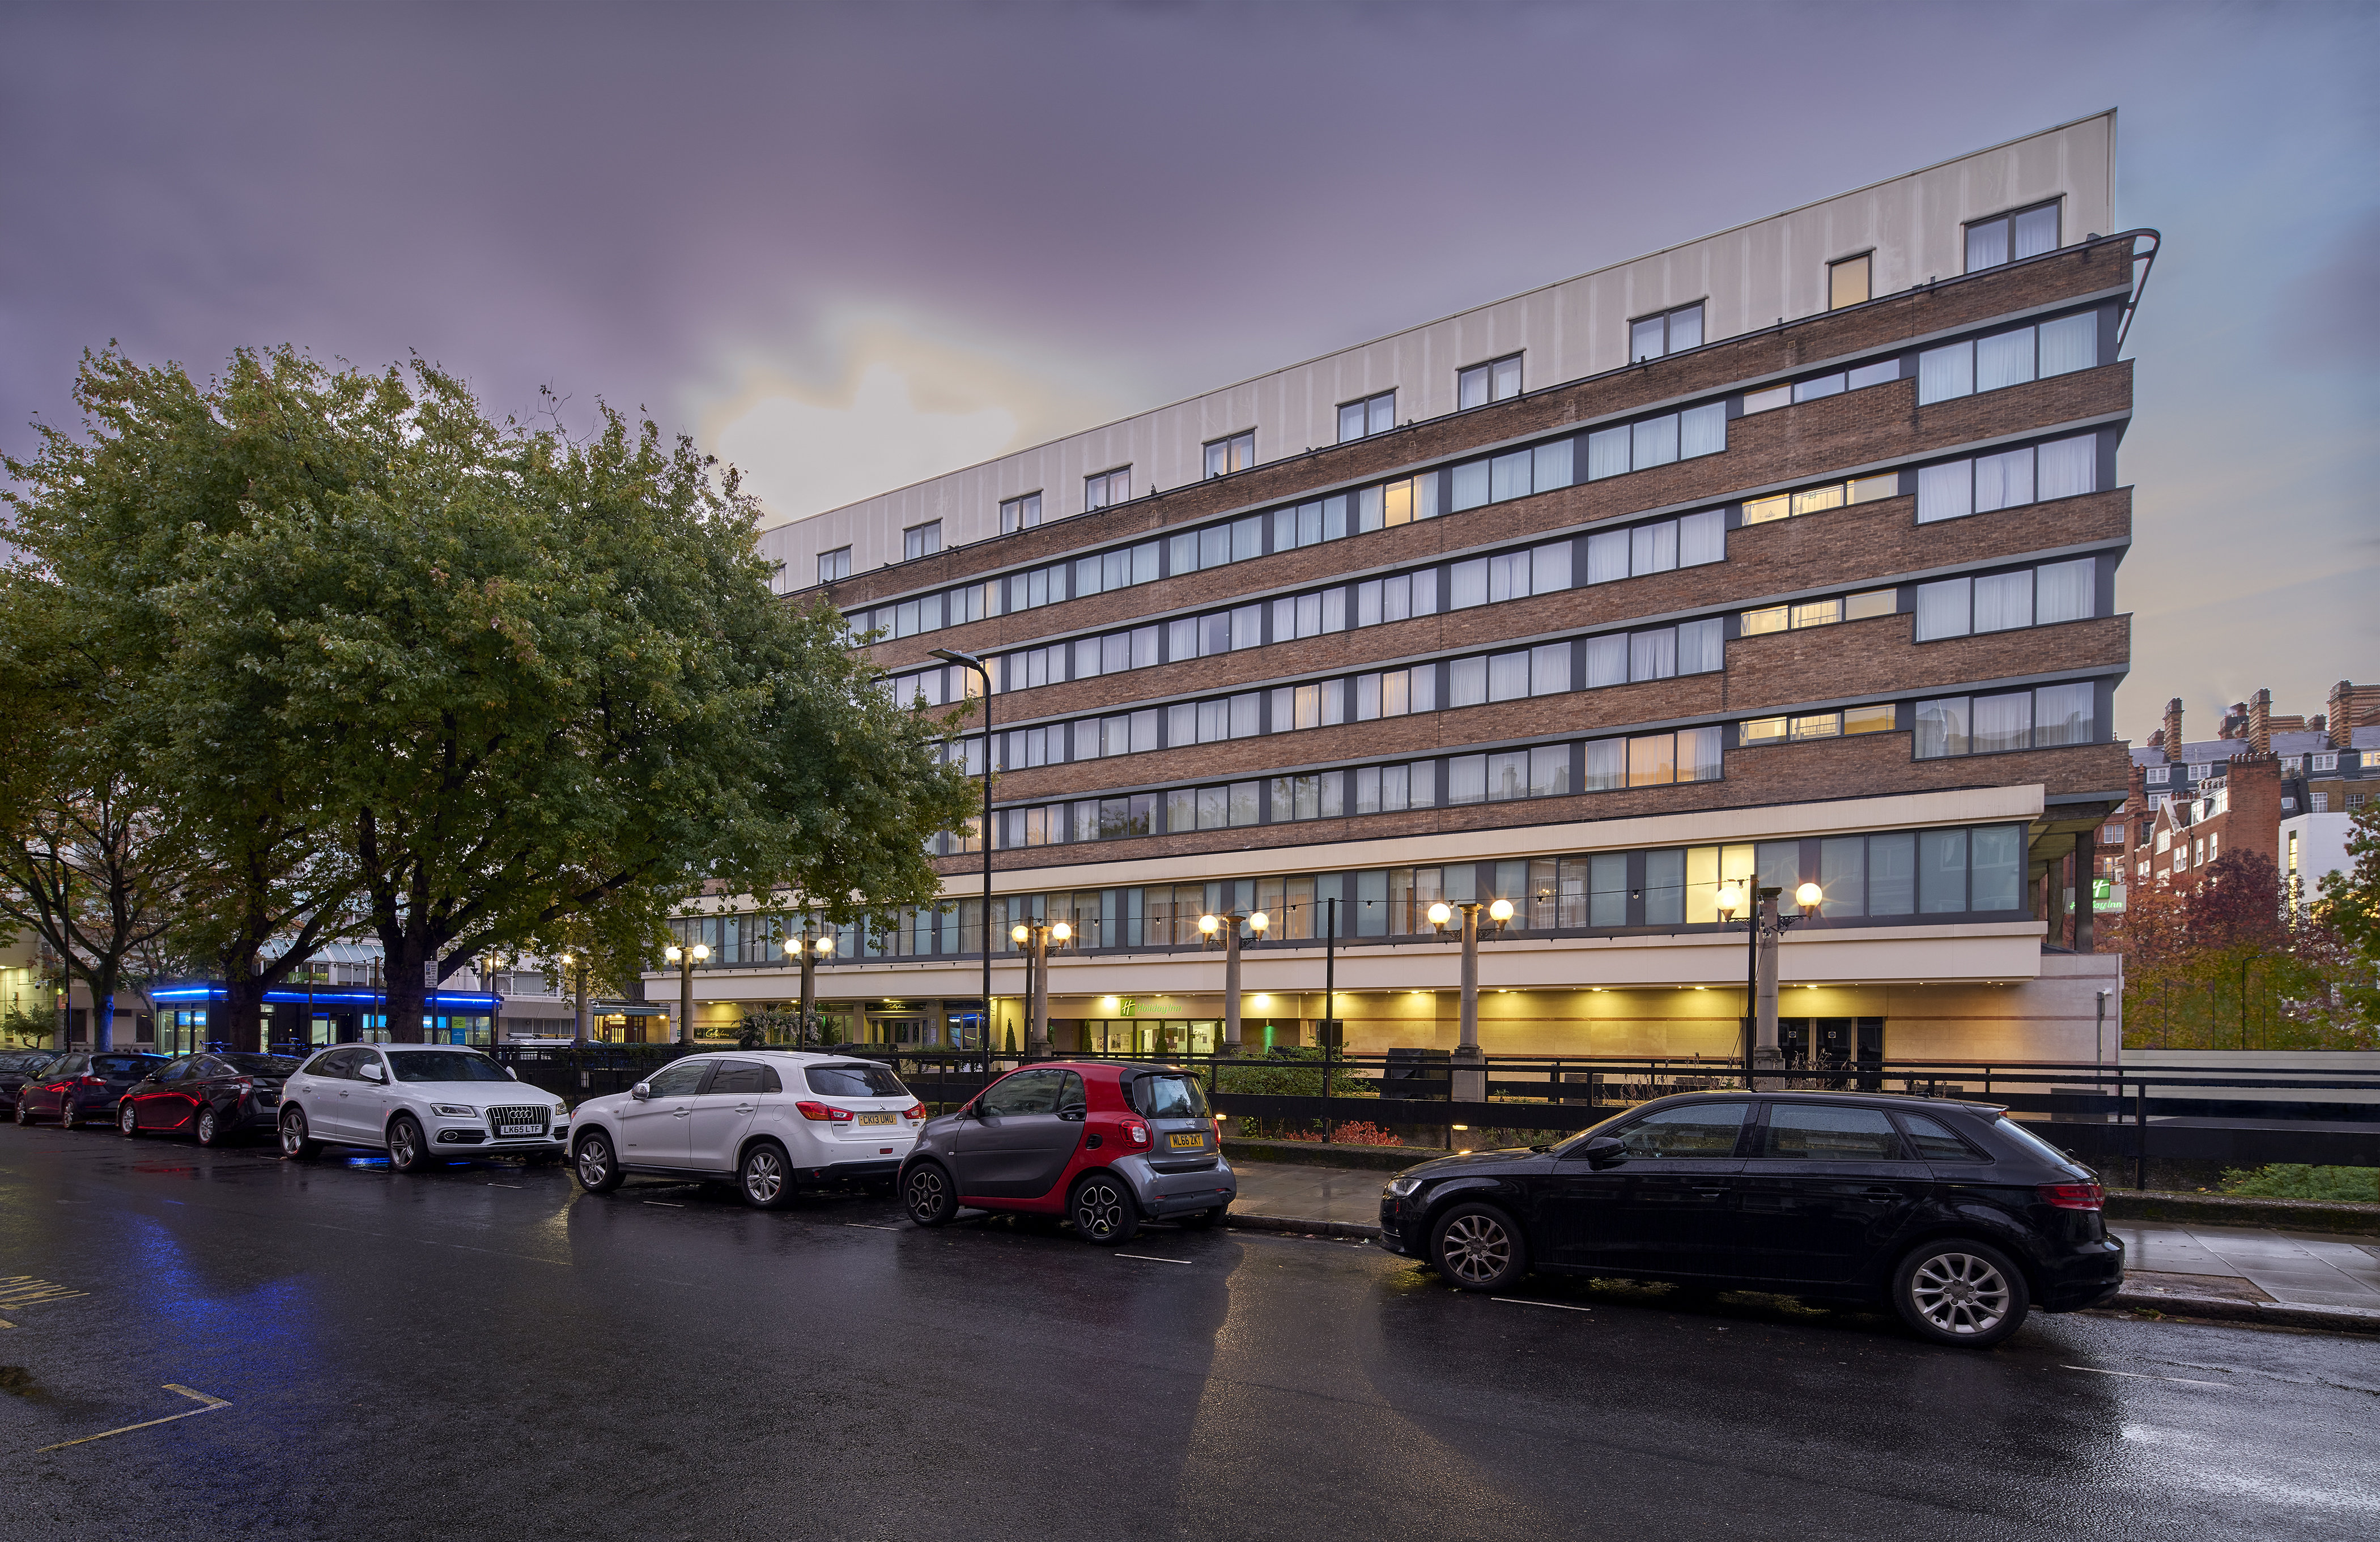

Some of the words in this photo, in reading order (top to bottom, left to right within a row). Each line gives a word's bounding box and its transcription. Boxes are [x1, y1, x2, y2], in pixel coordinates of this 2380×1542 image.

[2107, 900, 2123, 908] Inn
[1137, 1003, 1168, 1015] Holiday
[1168, 1003, 1182, 1012] Inn
[863, 1115, 878, 1124] CK13
[881, 1115, 894, 1123] UMU
[1172, 1135, 1189, 1146] ML66
[1190, 1135, 1201, 1145] ZKT
